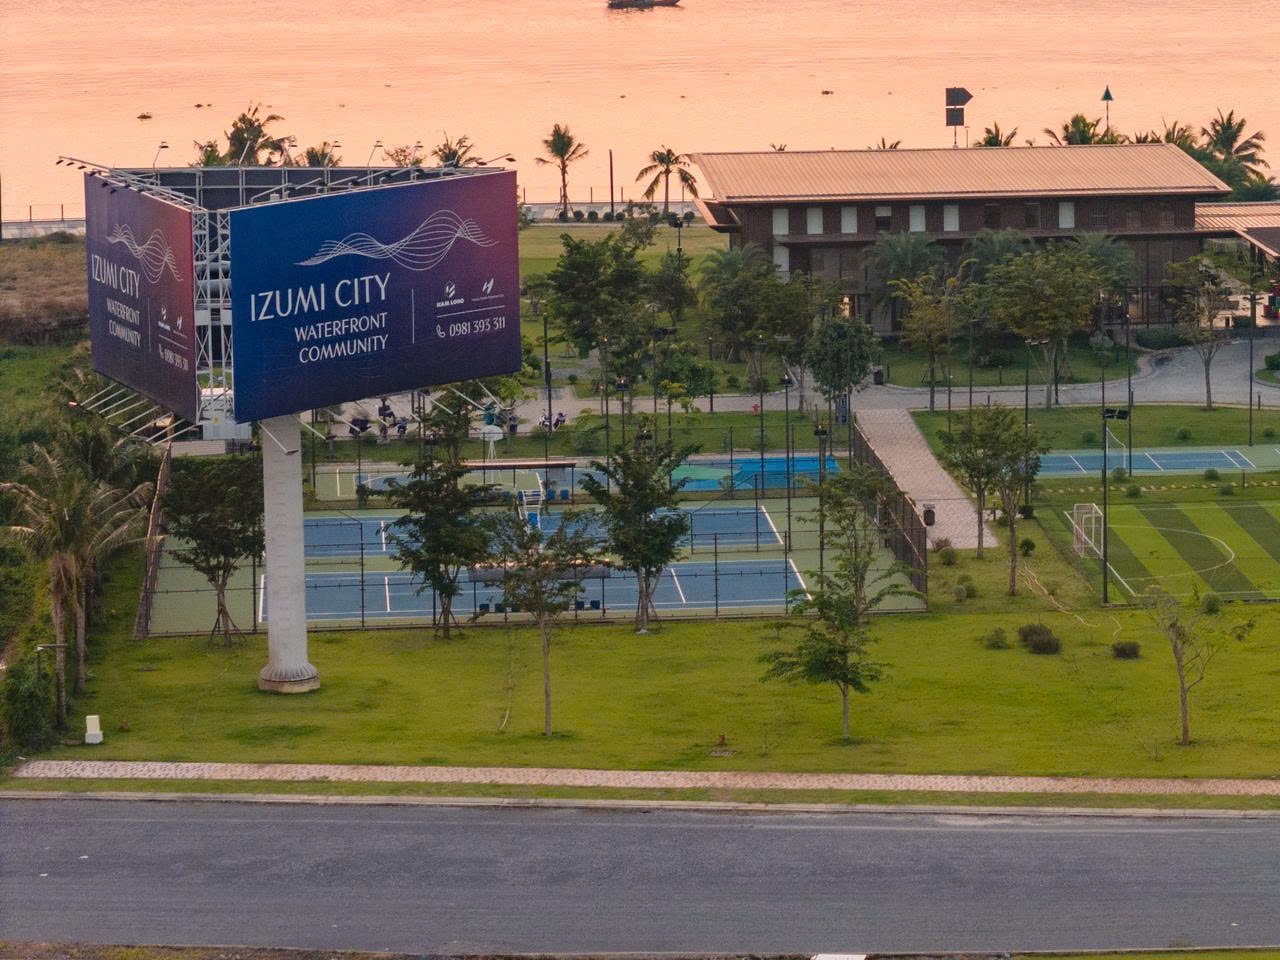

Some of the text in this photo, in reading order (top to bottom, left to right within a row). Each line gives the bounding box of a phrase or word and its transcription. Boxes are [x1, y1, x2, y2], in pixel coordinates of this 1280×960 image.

[91, 253, 140, 299] IZUMI CITY
[106, 297, 141, 326] WATERFRONT
[250, 272, 391, 322] IZUMI CITY
[108, 319, 141, 348] COMMUNITY
[294, 312, 389, 343] WATERFRONT
[449, 315, 506, 338] 0981 393 311
[299, 334, 389, 364] COMMUNITY
